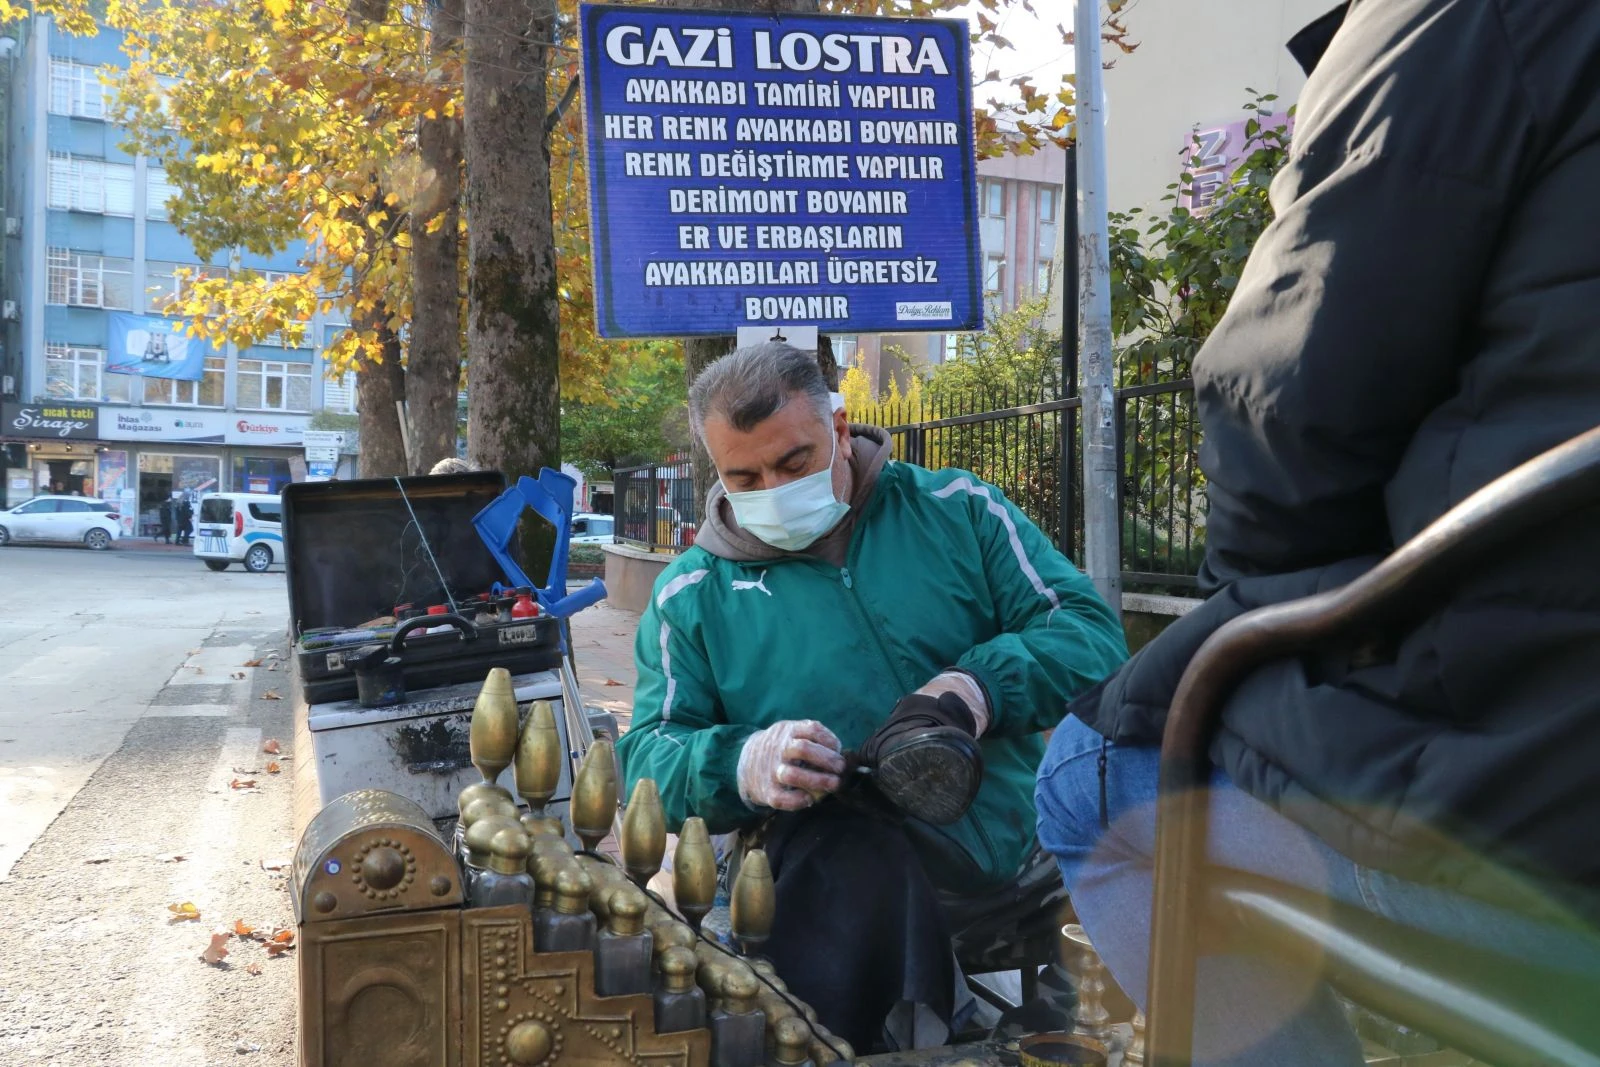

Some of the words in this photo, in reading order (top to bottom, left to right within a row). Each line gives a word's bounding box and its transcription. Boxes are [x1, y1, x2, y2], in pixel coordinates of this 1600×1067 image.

[755, 31, 949, 75] LOSTRA
[626, 78, 746, 105] AYAKKABI
[754, 79, 841, 108] TAMİRİ
[847, 85, 936, 110] YAPILIR
[604, 114, 654, 140] HER
[662, 116, 728, 141] RENK
[736, 117, 852, 143] AYAKKABI
[860, 120, 958, 145] BOYANIR
[625, 151, 692, 177] RENK
[700, 149, 850, 182] DEĞİŞTİRME
[855, 155, 944, 180] YAPILIR
[669, 185, 799, 214] DERİMONT
[806, 190, 908, 214] BOYANIR
[679, 225, 711, 249] ER
[717, 225, 749, 249] VE
[756, 225, 903, 253] ERBAŞLARIN
[645, 261, 819, 286] AYAKKABILARI
[827, 256, 938, 284] ÜCRETSİZ
[745, 296, 849, 320] BOYANIR
[42, 407, 68, 418] sıcak
[70, 408, 94, 419] tatlı
